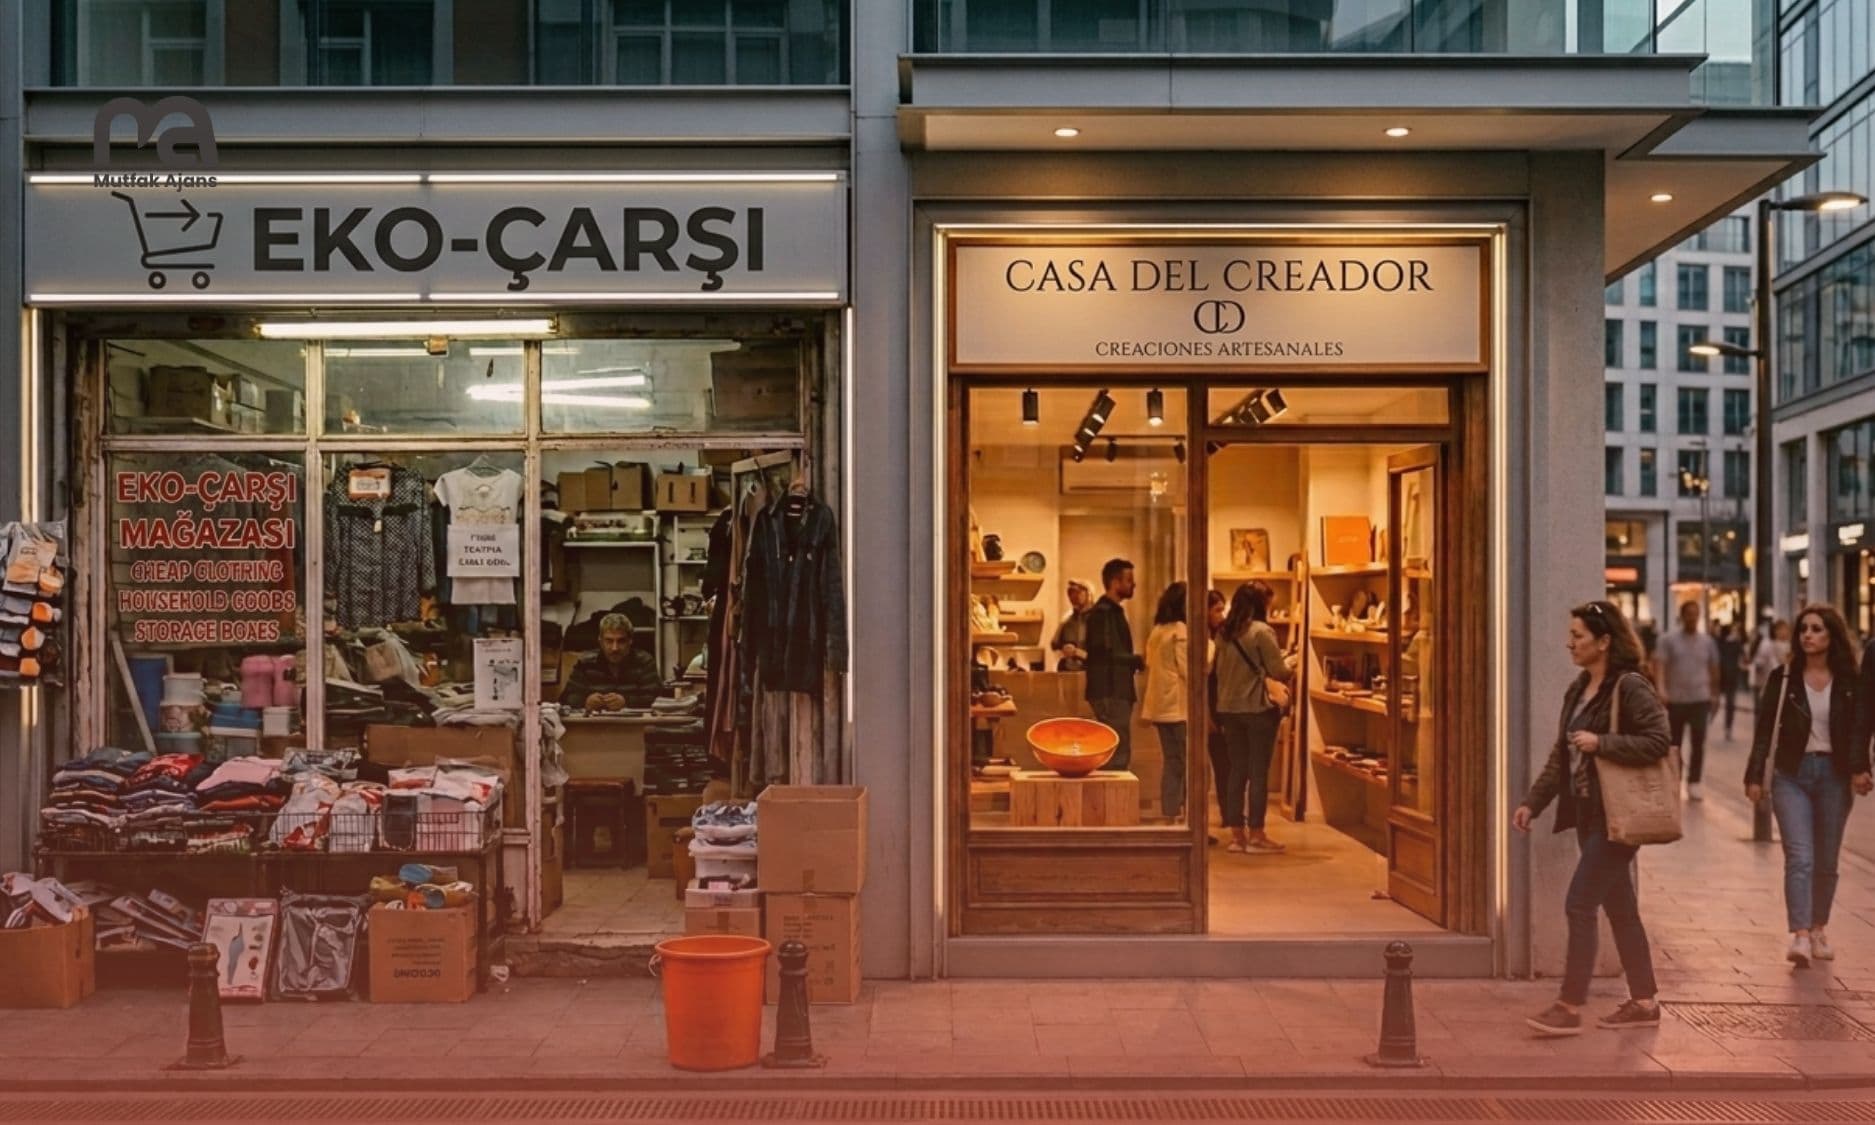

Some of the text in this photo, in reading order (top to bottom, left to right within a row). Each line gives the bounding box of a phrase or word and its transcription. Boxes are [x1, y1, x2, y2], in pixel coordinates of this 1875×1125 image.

[253, 206, 764, 292] EKO-ÇARŞI
[1005, 259, 1434, 292] CASA DEL CREADOR
[1095, 342, 1344, 357] CREACIONES ARTESANALES
[116, 471, 297, 511] EKO-ÇARŞI
[119, 510, 296, 549] MAĞAZASI
